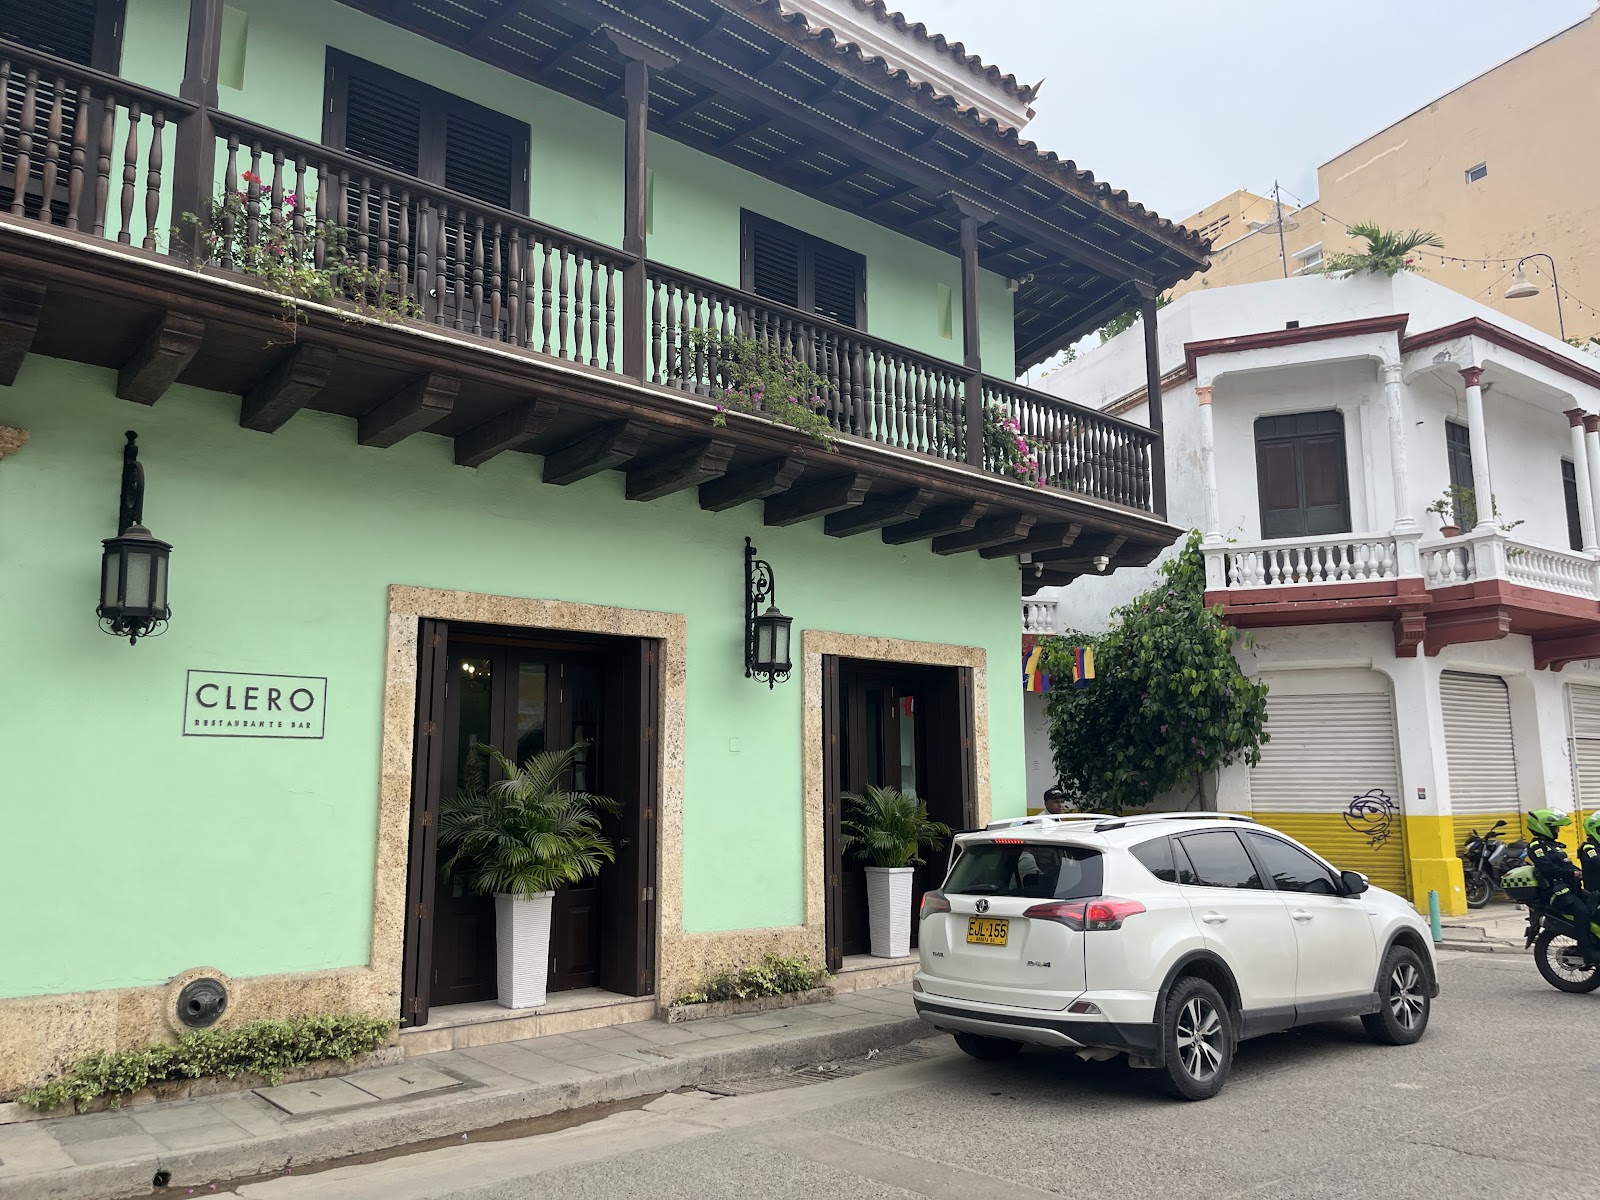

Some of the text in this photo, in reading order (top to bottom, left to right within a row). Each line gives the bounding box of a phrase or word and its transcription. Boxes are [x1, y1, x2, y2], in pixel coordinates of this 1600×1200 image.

[195, 683, 315, 712] CLERO
[194, 719, 311, 729] RESTAURANTE BAR
